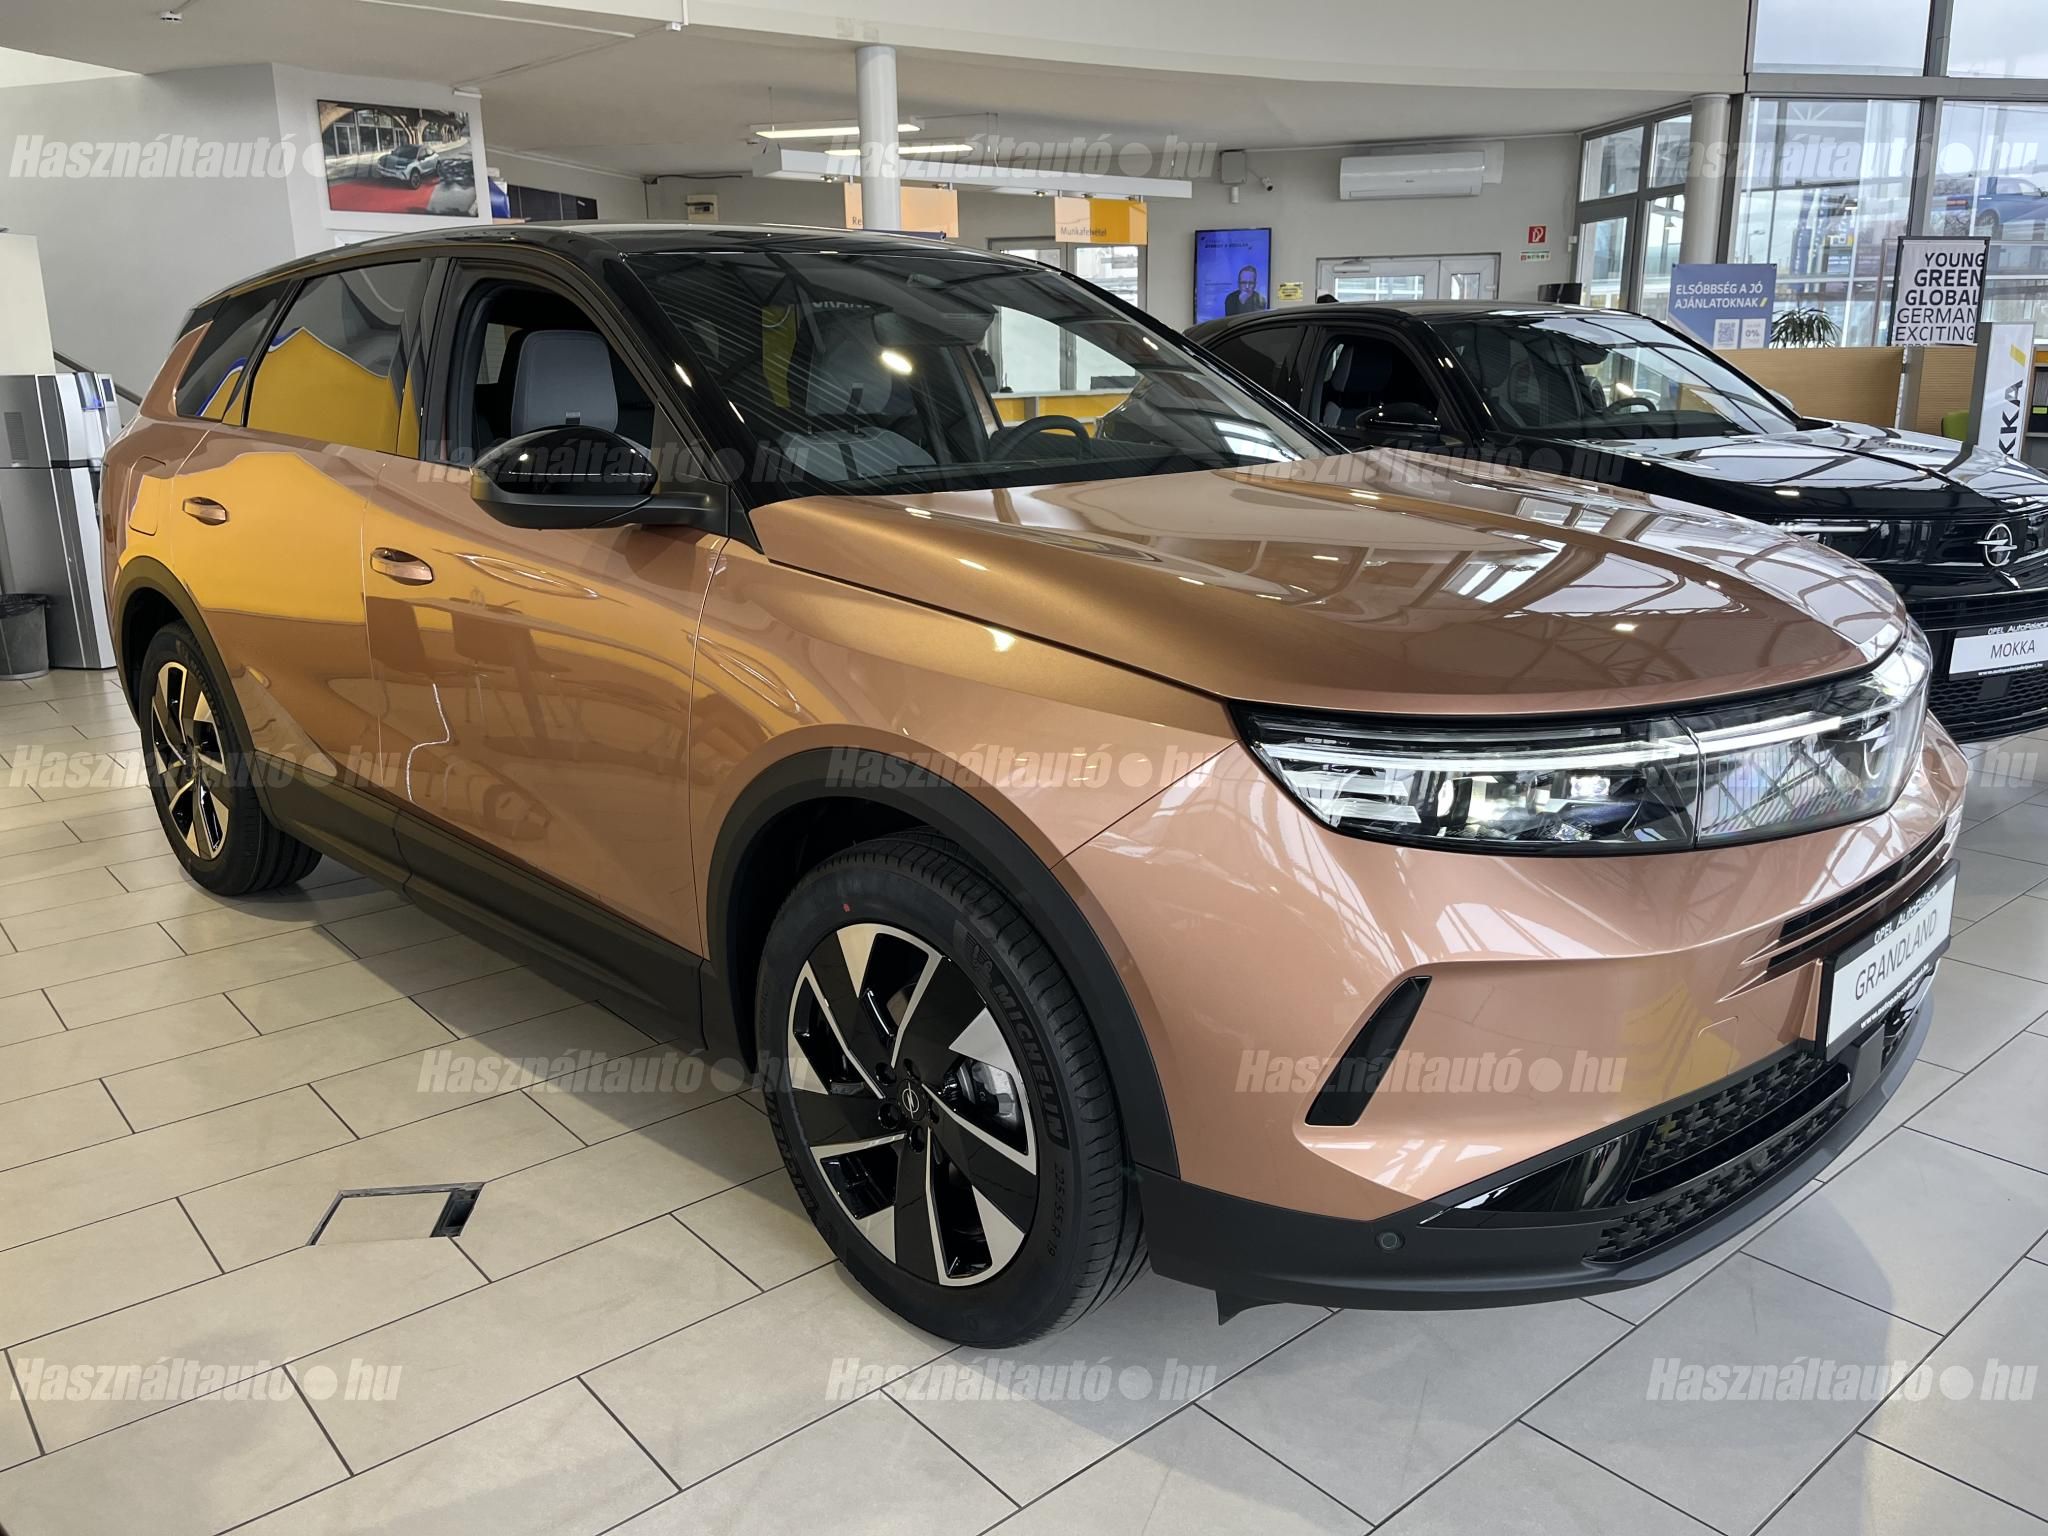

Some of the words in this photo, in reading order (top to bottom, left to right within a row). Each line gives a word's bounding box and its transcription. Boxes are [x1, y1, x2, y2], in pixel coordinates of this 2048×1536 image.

[1925, 252, 1985, 268] YOUNG
[1914, 269, 1982, 287] GREEN
[1676, 281, 1737, 295] ELSŐBBSÉG
[1739, 284, 1747, 293] A
[1749, 281, 1763, 293] JÓ
[1674, 296, 1759, 309] AJÁNLATOKNAK
[1905, 289, 1979, 306] GLOBAL
[1897, 307, 1977, 324] GERMAN
[1895, 326, 1975, 341] EXCITING
[1999, 379, 2024, 458] KKA
[1990, 639, 2036, 659] MOKKA
[1873, 920, 1893, 945] OPEL
[1855, 908, 1938, 1001] GRANDLAND
[993, 983, 1067, 1145] MICHELIN
